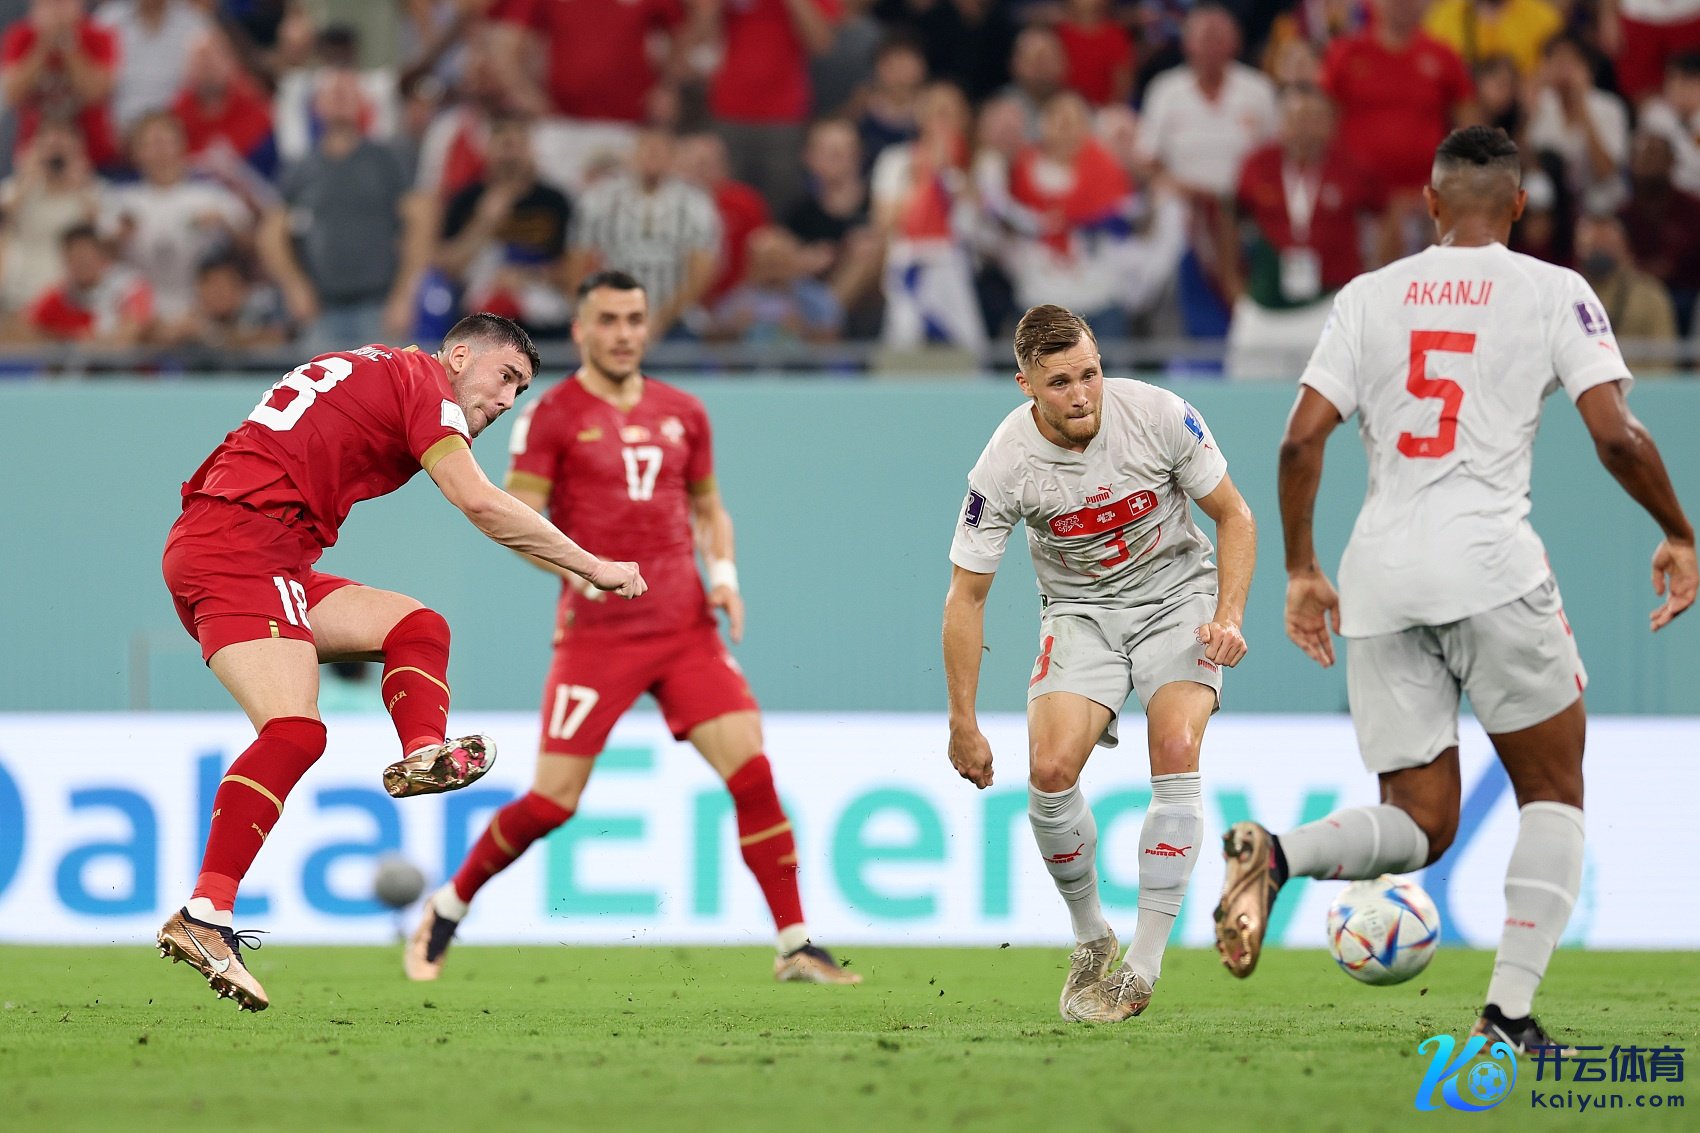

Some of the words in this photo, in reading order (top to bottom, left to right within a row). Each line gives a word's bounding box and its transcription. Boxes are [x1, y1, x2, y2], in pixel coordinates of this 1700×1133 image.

[1403, 280, 1493, 306] AKANJI
[1397, 330, 1477, 458] 5
[621, 444, 664, 501] 17
[1085, 491, 1111, 504] PUMA
[1099, 526, 1131, 569] 3
[548, 684, 600, 740] 17
